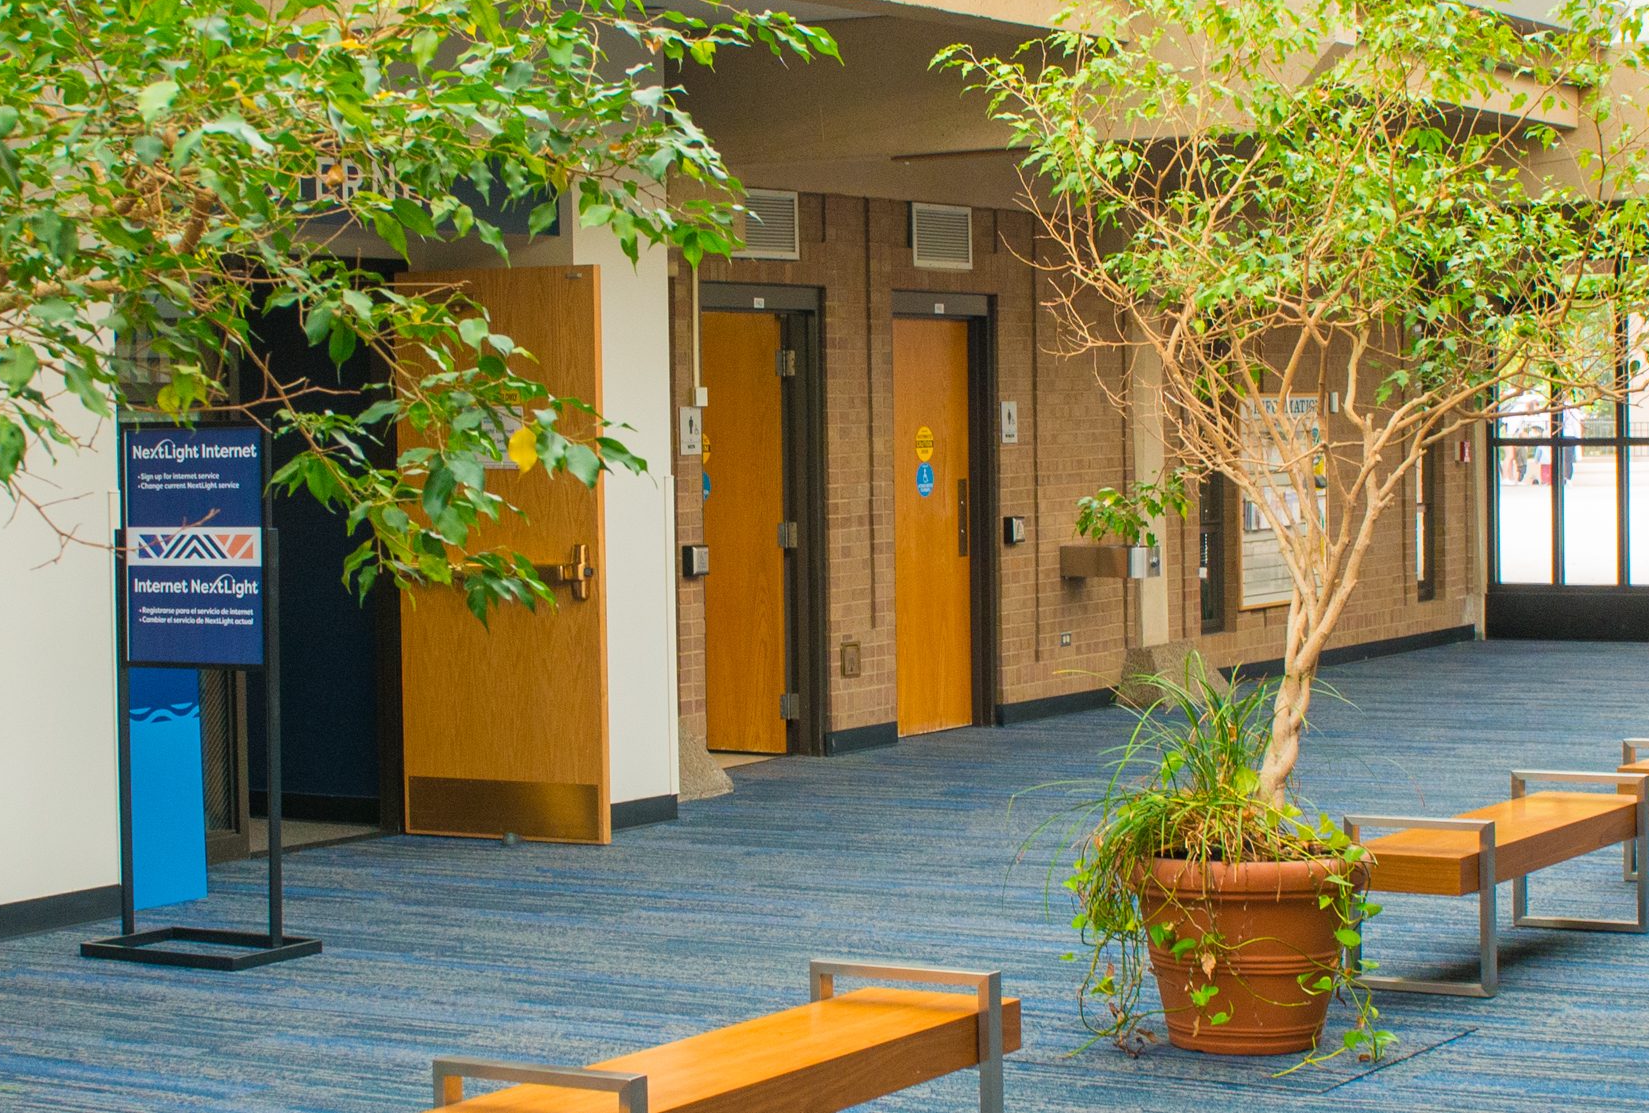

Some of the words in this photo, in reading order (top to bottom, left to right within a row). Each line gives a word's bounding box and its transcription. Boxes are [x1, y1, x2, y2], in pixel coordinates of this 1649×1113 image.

[132, 439, 200, 463] NextLight
[202, 444, 257, 458] Internet
[140, 473, 153, 481] Sign
[140, 482, 163, 491] Change
[187, 482, 217, 491] NextLight
[134, 578, 188, 593] Internet
[191, 574, 259, 598] NextLight
[142, 606, 174, 615] Registrarse
[205, 617, 234, 626] NextLight
